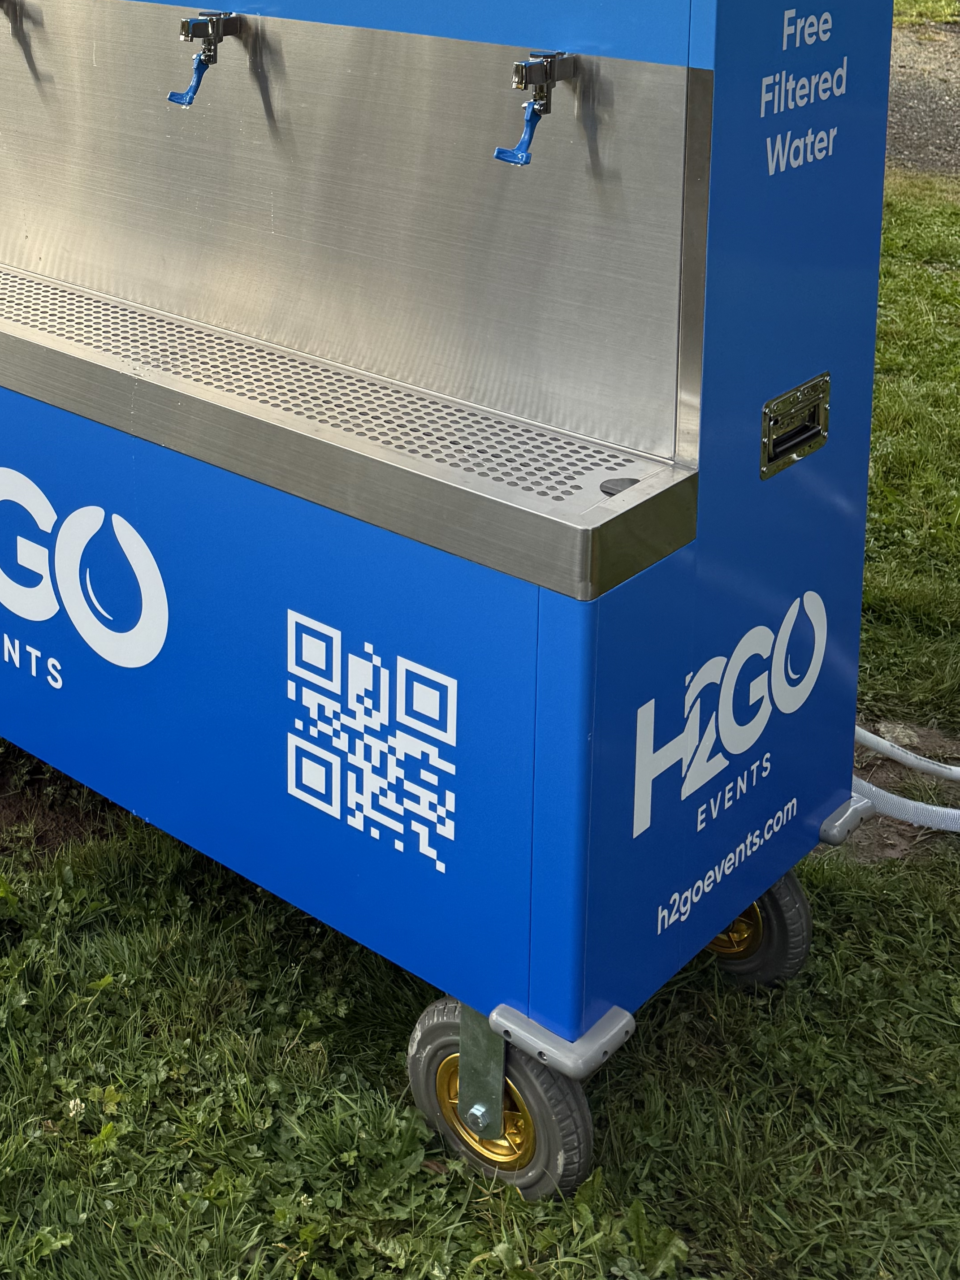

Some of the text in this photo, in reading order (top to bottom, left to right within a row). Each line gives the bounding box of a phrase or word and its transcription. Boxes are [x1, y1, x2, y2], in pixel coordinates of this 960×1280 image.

[782, 9, 833, 51] Free
[760, 56, 847, 118] Filtered
[766, 126, 837, 176] Water
[633, 590, 828, 839] H2GO
[696, 752, 771, 833] EVENTS
[657, 796, 798, 936] h2goevents.com
